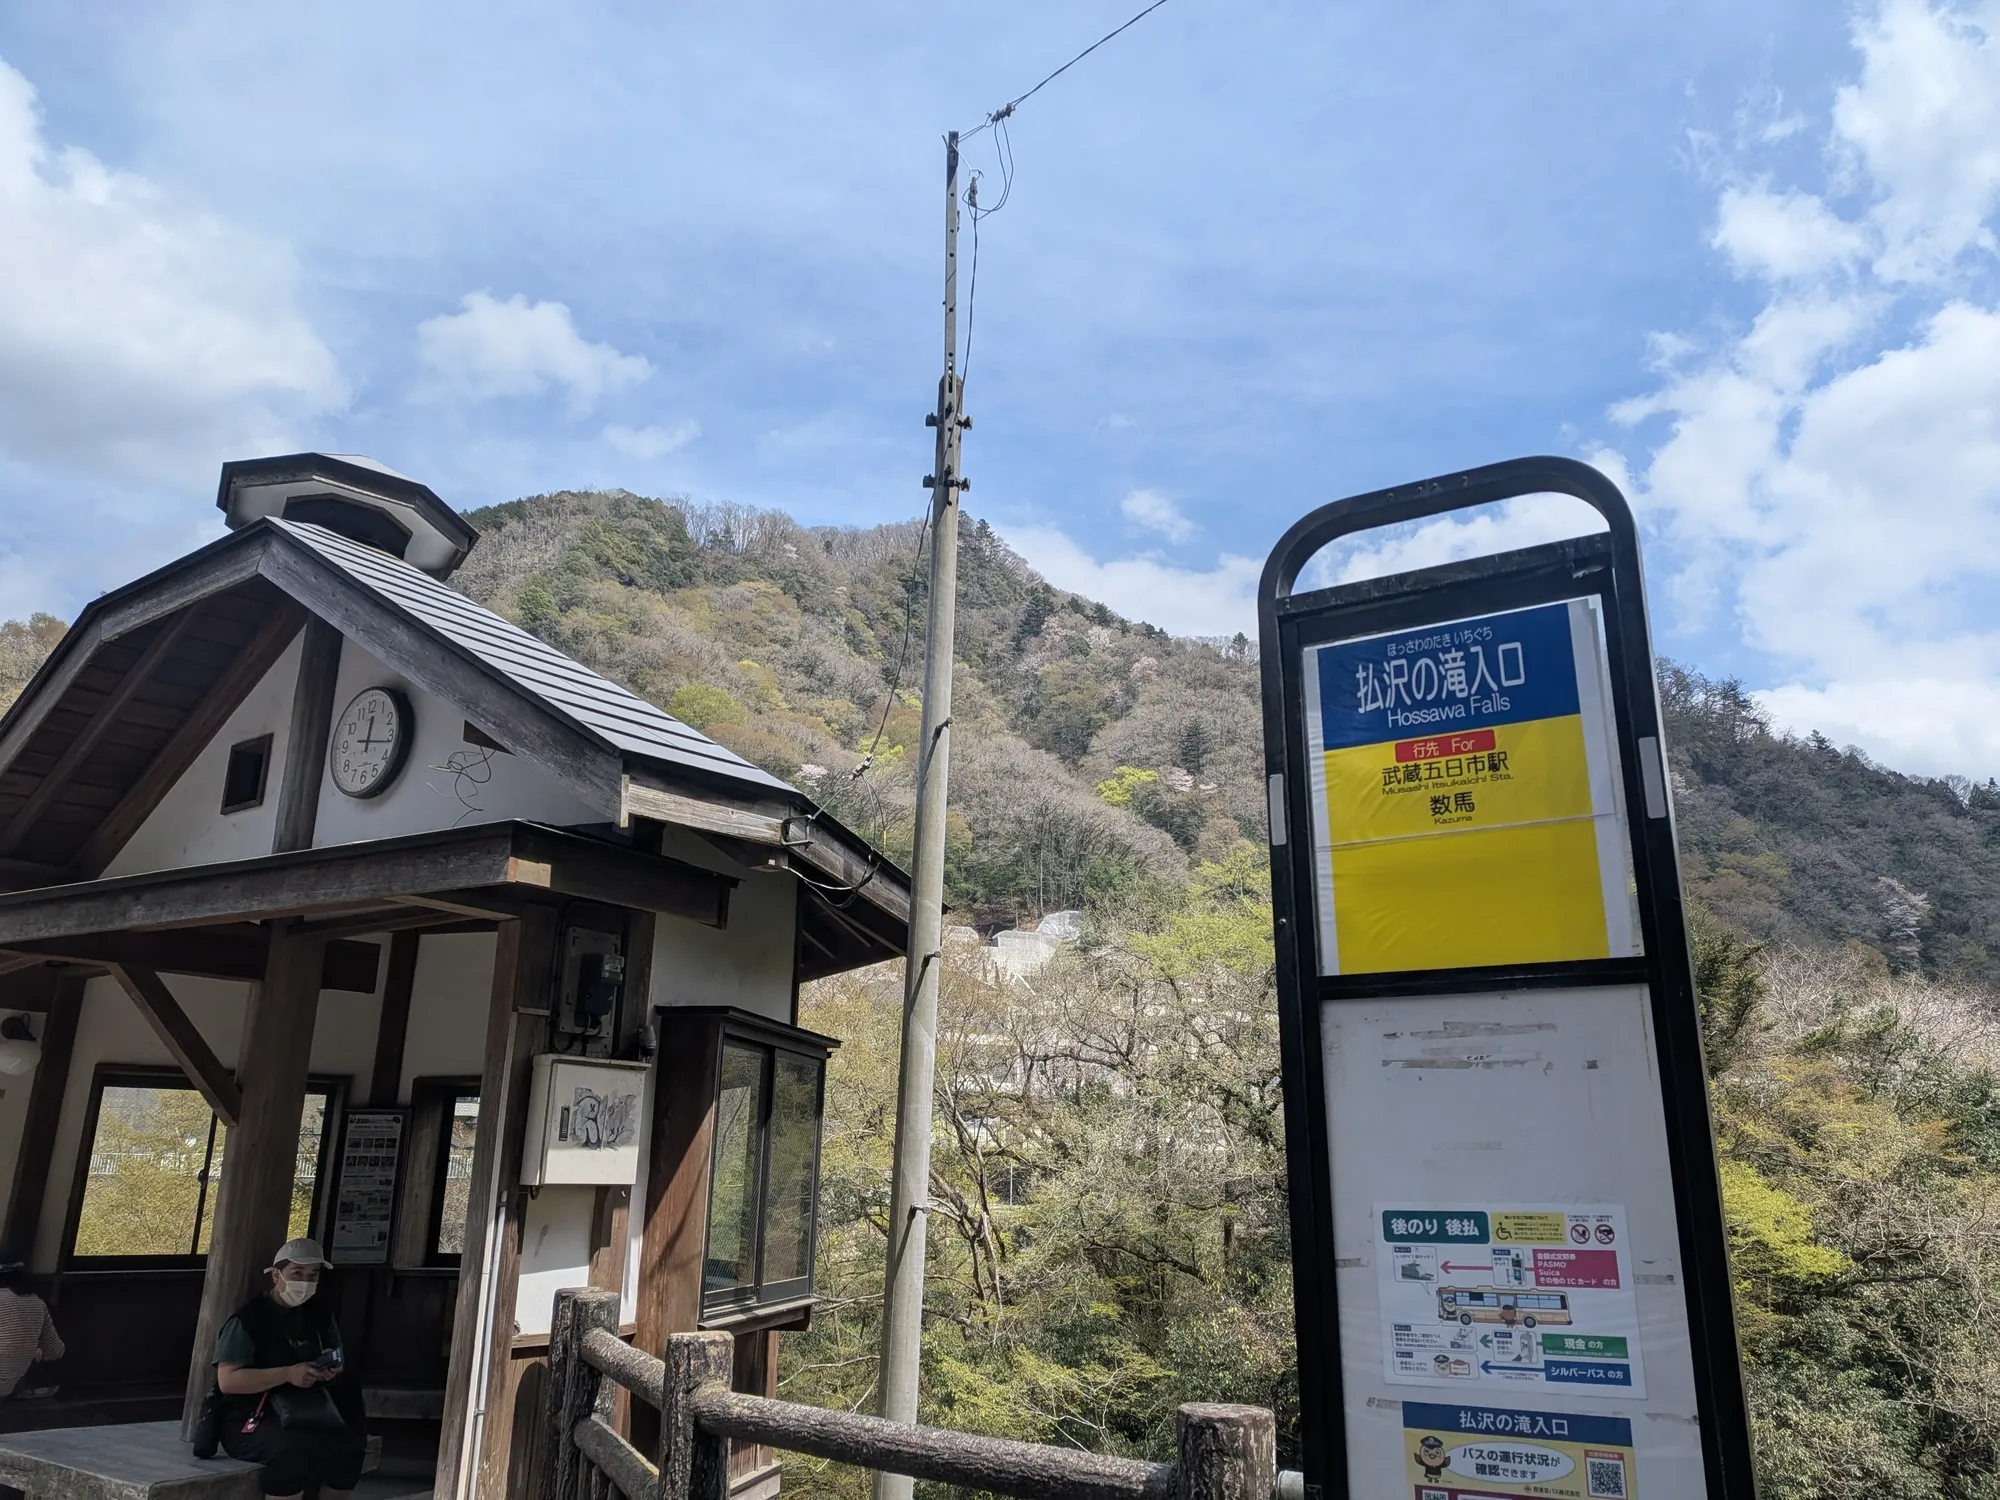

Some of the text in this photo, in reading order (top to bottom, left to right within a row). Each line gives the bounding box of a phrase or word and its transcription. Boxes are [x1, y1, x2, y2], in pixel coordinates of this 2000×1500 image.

[1356, 642, 1525, 713] 払沢の滝入口
[368, 700, 376, 713] 12
[381, 702, 385, 714] 1
[1387, 693, 1511, 728] Hossawa Falls
[357, 708, 365, 721] 11
[386, 712, 393, 725] 2
[347, 723, 356, 736] 10
[387, 729, 394, 742] 3
[341, 741, 348, 754] 9
[1412, 737, 1476, 759] 行先 For
[381, 749, 388, 762] 4
[343, 759, 350, 773] 8
[371, 764, 378, 778] 5
[1382, 751, 1509, 786] 武蔵五日市駅
[351, 769, 357, 783] 7
[360, 771, 367, 784] 6
[1381, 773, 1515, 796] Musashi Itsukaichi Sta.
[1429, 791, 1476, 817] 数馬
[1433, 815, 1473, 825] Kazuma
[1391, 1218, 1480, 1237] 後のり 後払
[1538, 1269, 1560, 1277] Suica
[1564, 1338, 1604, 1350] 現金 の方
[1550, 1366, 1606, 1379] シルバーパス
[1607, 1370, 1624, 1379] の方
[1459, 1410, 1569, 1436] 払沢の滝入口
[1462, 1447, 1561, 1467] バスの運行状況が
[1475, 1463, 1538, 1480] 確認できます
